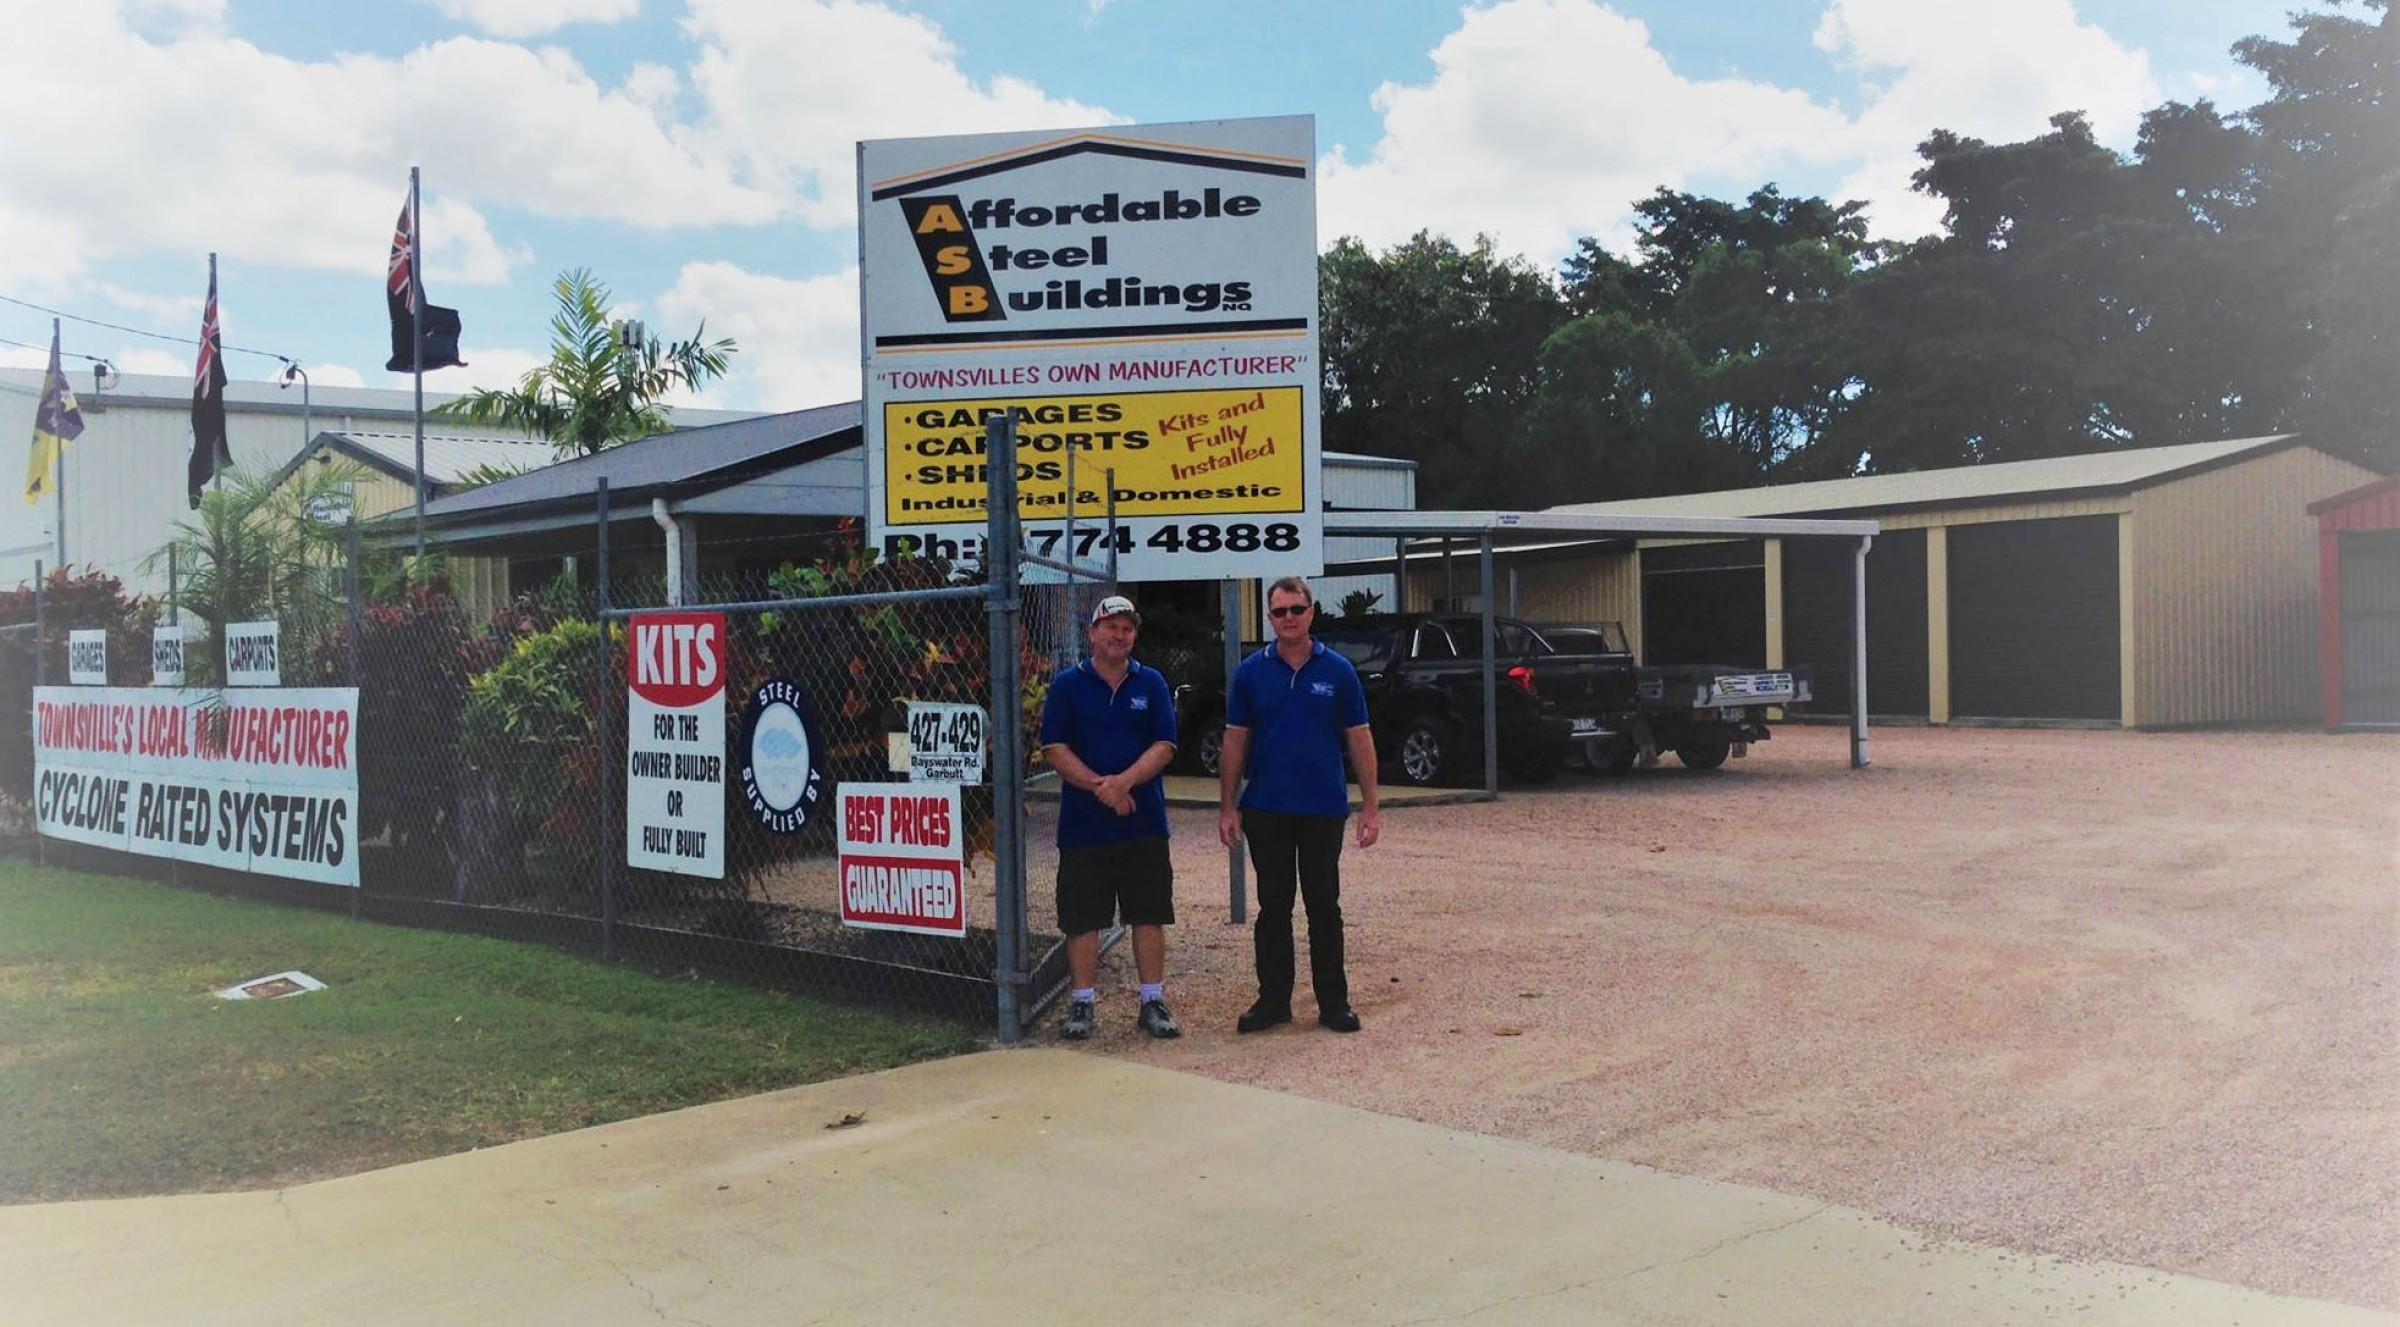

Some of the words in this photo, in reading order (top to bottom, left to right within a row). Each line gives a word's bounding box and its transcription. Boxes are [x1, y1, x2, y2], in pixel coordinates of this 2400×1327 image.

[917, 188, 1262, 234] Affordable
[936, 236, 1108, 276] Steel
[949, 276, 1252, 315] Buildings
[1222, 303, 1252, 312] NQ
[877, 363, 1040, 390] "TOWNSVILLES
[1048, 362, 1101, 383] OWN
[1109, 355, 1308, 381] MANUFACTURER"
[1158, 414, 1210, 437] Kits
[1218, 392, 1266, 421] and
[1186, 424, 1248, 453] Fully
[1171, 437, 1275, 481] Installed
[1075, 491, 1100, 504] &
[1114, 484, 1282, 502] Domestic
[1147, 524, 1300, 553] 4888
[636, 623, 718, 687] KITS
[759, 681, 800, 708] STEEL
[38, 702, 134, 754] TOWNSVILLE'S
[139, 705, 188, 758] LOCAL
[654, 714, 675, 741] FOR
[678, 715, 699, 742] THE
[910, 712, 981, 753] 427-429
[632, 752, 671, 779] OWNER
[675, 755, 721, 784] BUILDER
[911, 756, 962, 768] Bayswater
[926, 768, 964, 779] Garbutt
[39, 769, 129, 835] CYCLONE
[135, 782, 212, 847] RATED
[217, 789, 347, 868] SYSTEMS
[667, 790, 683, 817] OR
[742, 767, 806, 833] SUPPLIED
[806, 768, 821, 803] BY
[845, 796, 884, 843] BEST
[890, 796, 951, 848] PRICES
[643, 826, 672, 856] FULLY
[676, 829, 707, 859] BUILT
[847, 864, 956, 919] GUARANTEED
